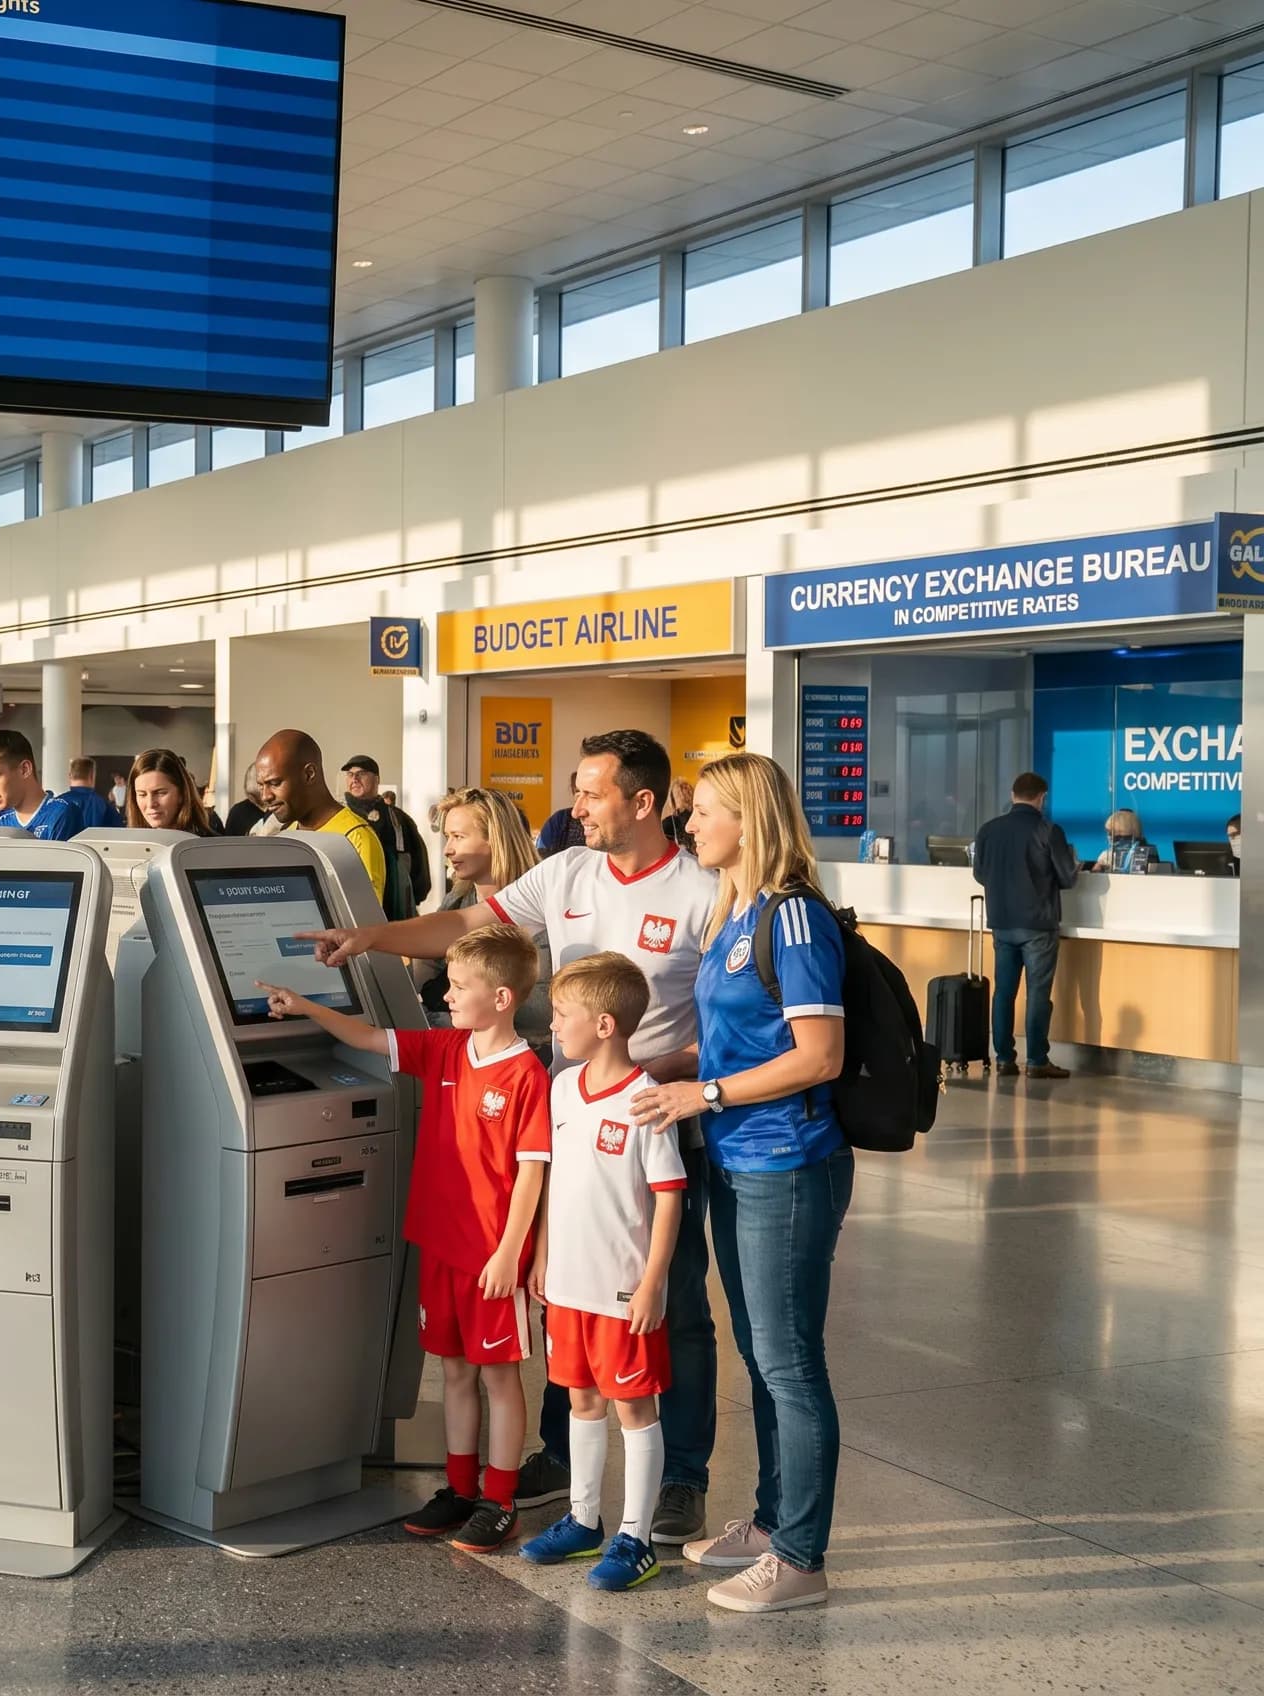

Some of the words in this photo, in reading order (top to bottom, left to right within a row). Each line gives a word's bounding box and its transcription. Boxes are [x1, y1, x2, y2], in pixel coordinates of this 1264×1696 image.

[790, 573, 920, 612] CURRENCY
[924, 555, 1074, 599] EXCHANGE
[1082, 540, 1212, 583] BUREAU
[473, 617, 569, 653] BUDGET
[574, 605, 678, 646] AIRLINE
[893, 608, 910, 626] IN
[912, 598, 1019, 625] COMPETITIVE
[1022, 592, 1080, 615] RATES
[1123, 771, 1243, 791] COMPETITIV
